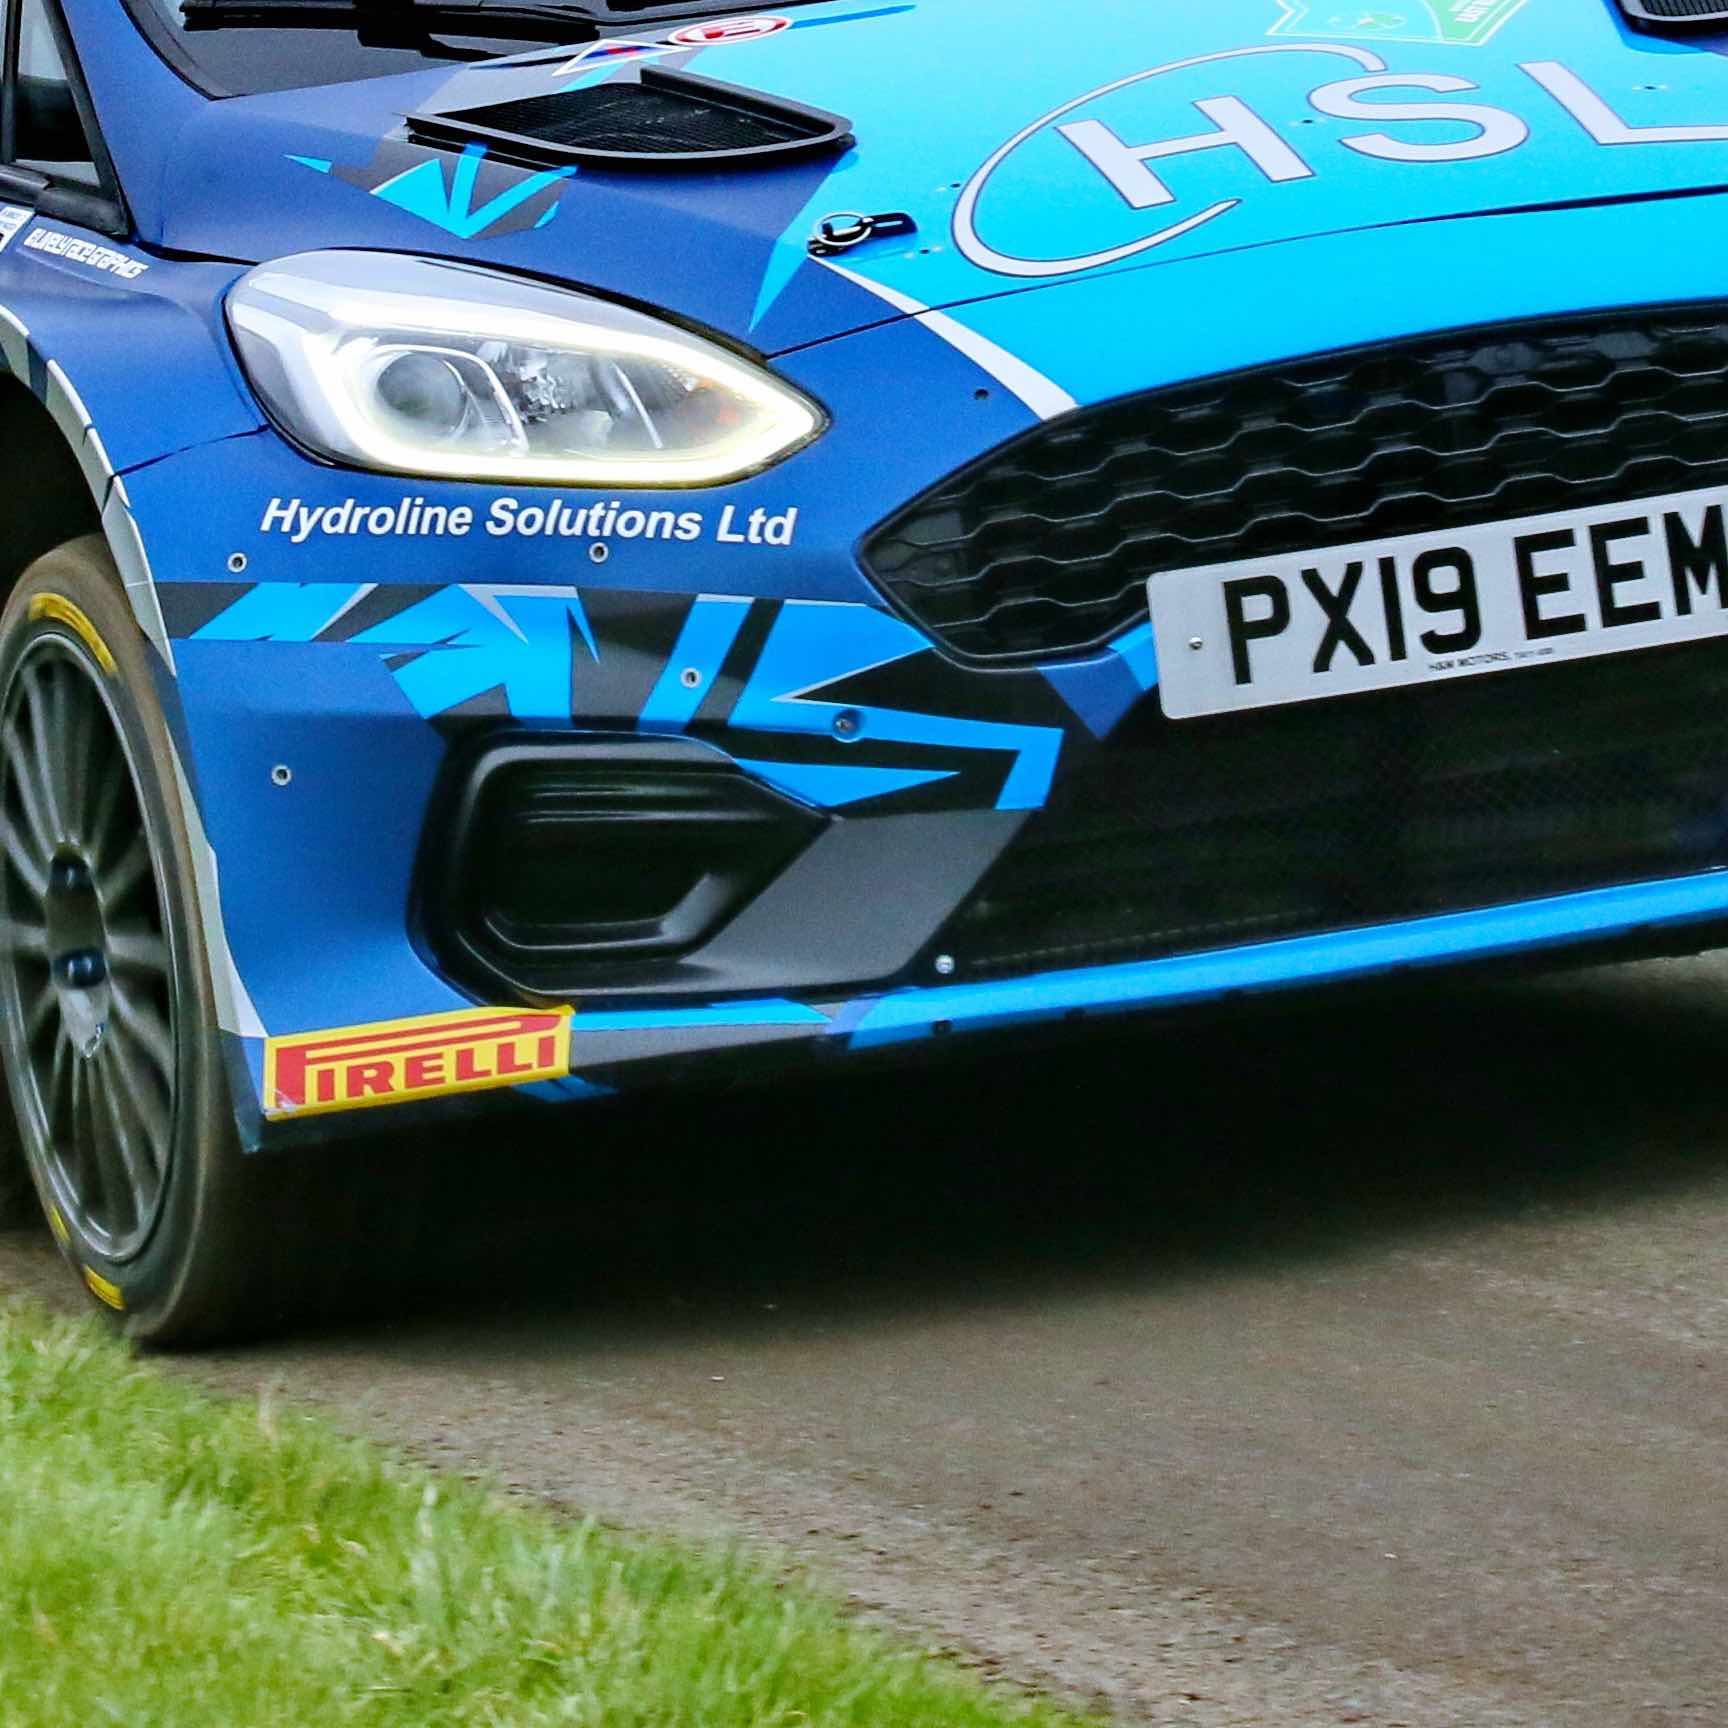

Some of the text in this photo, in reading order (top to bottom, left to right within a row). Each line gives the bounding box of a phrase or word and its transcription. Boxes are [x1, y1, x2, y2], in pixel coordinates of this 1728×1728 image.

[259, 498, 798, 545] Hydroline Solutions Ltd
[1222, 546, 1483, 685] PX19
[275, 1014, 562, 1108] PIRELLI
